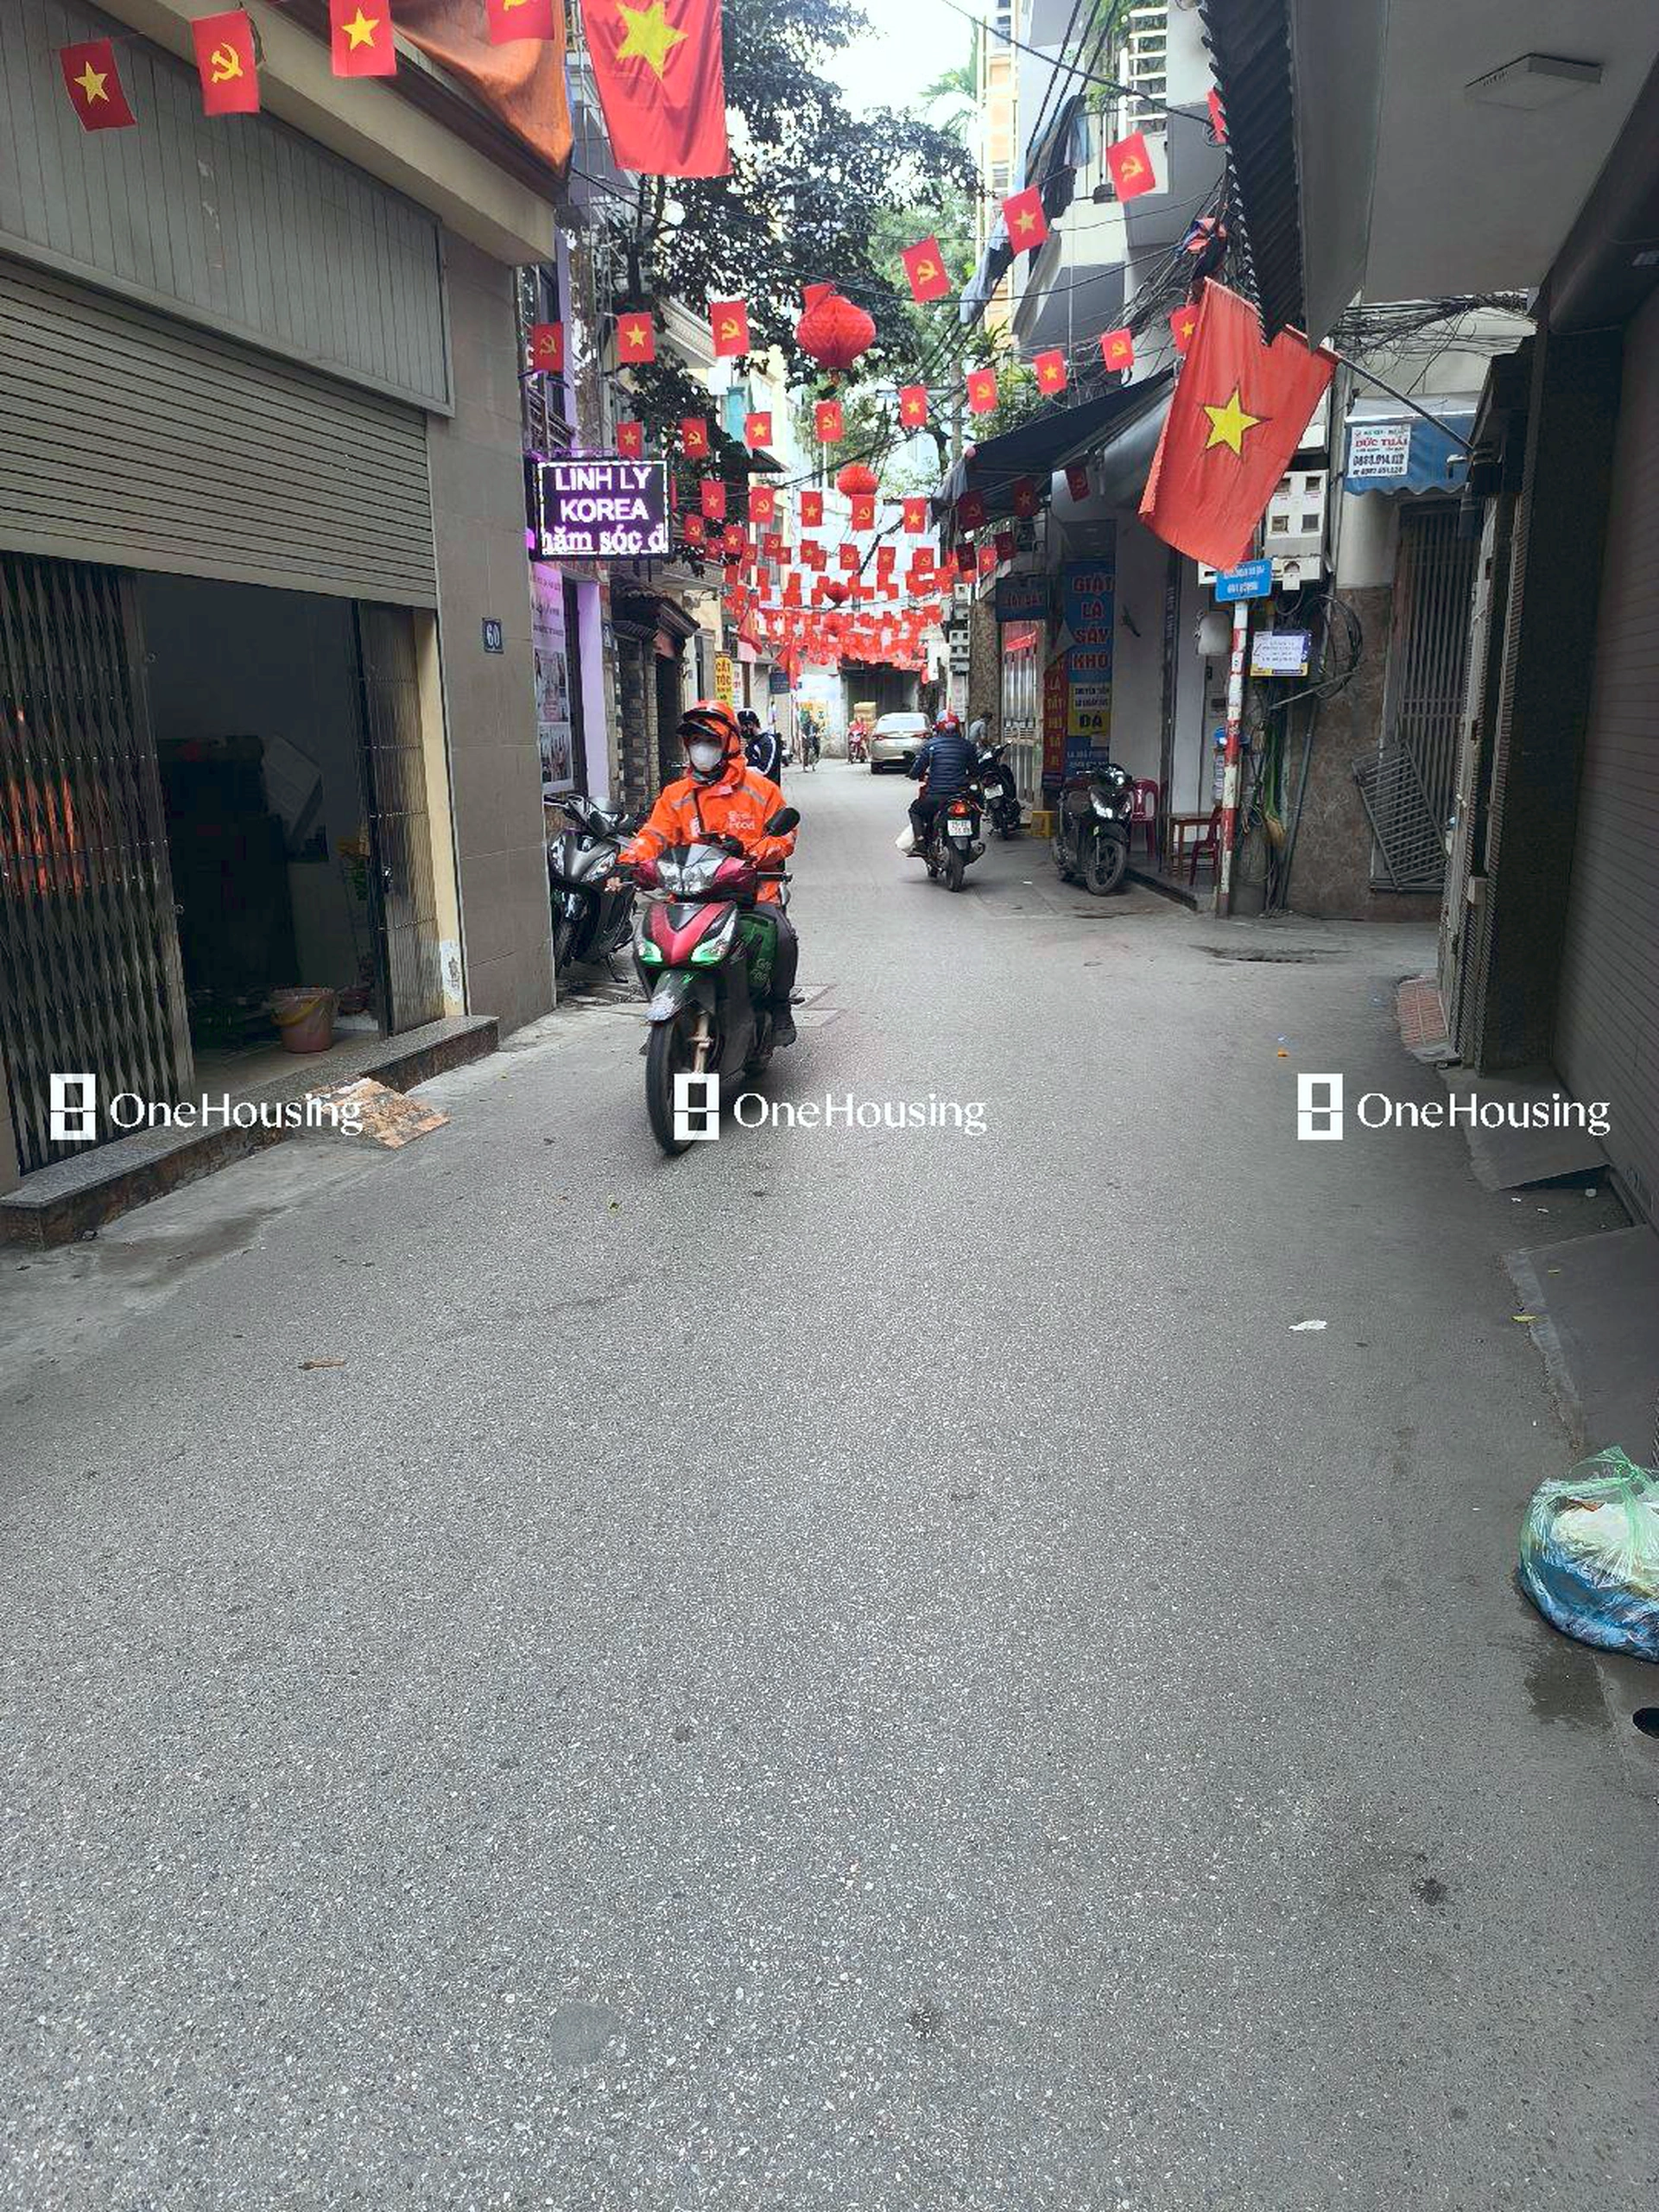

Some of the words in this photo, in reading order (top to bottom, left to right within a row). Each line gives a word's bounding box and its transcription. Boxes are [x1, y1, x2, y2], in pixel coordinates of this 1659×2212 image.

[554, 467, 612, 491] LINH
[620, 466, 652, 489] LY
[560, 498, 649, 523] KOREA
[599, 523, 643, 553] sóc
[486, 624, 500, 648] 60
